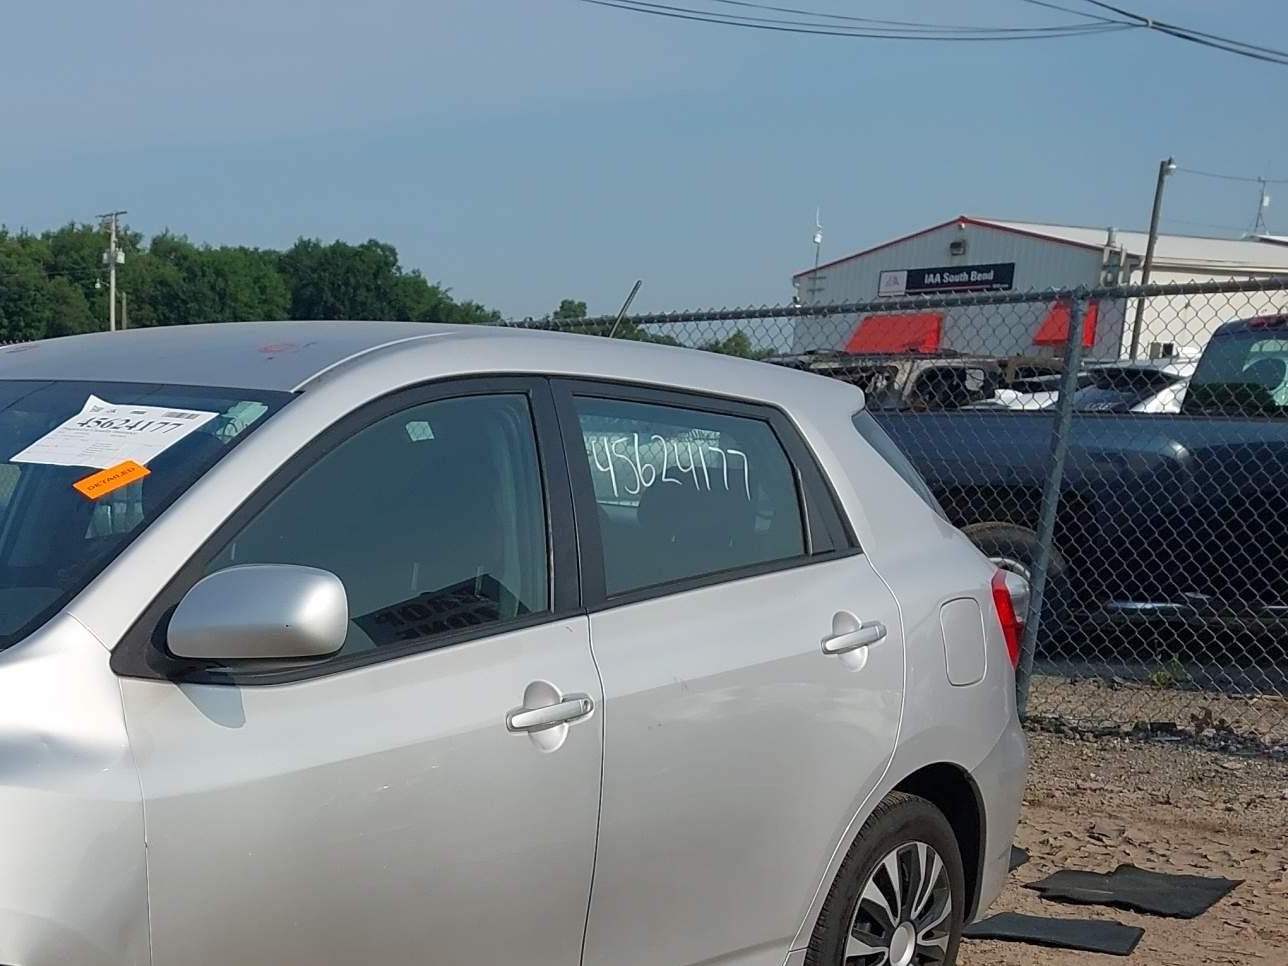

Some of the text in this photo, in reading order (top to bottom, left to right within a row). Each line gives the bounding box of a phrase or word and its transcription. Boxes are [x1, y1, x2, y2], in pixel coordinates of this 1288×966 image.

[924, 270, 994, 284] IAA South Bend
[76, 416, 184, 433] 45624177
[591, 432, 752, 502] 45624177
[86, 466, 137, 491] DETAILED
